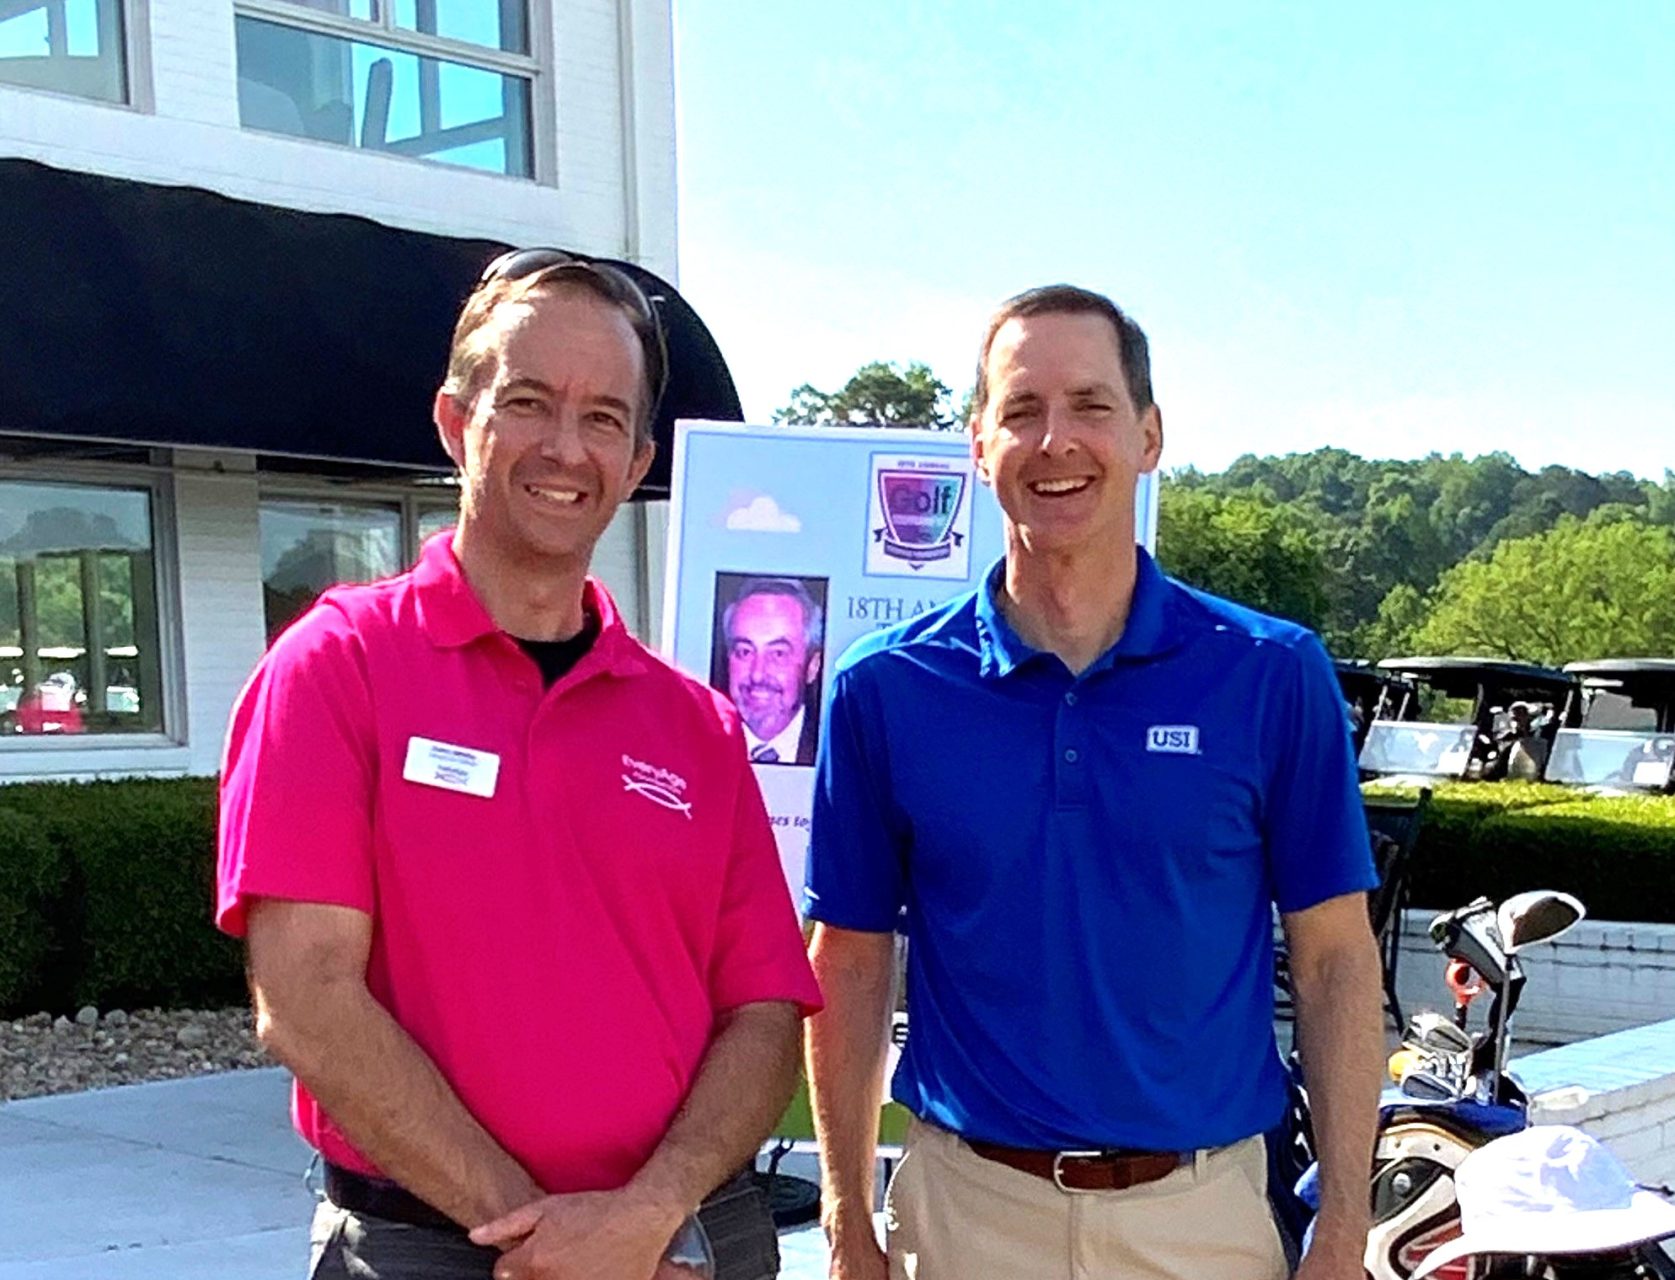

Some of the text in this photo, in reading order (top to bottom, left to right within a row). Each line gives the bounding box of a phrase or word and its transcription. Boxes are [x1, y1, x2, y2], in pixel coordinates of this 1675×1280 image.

[891, 485, 951, 514] Golf
[848, 597, 936, 620] 18TH A
[1153, 731, 1191, 748] USI
